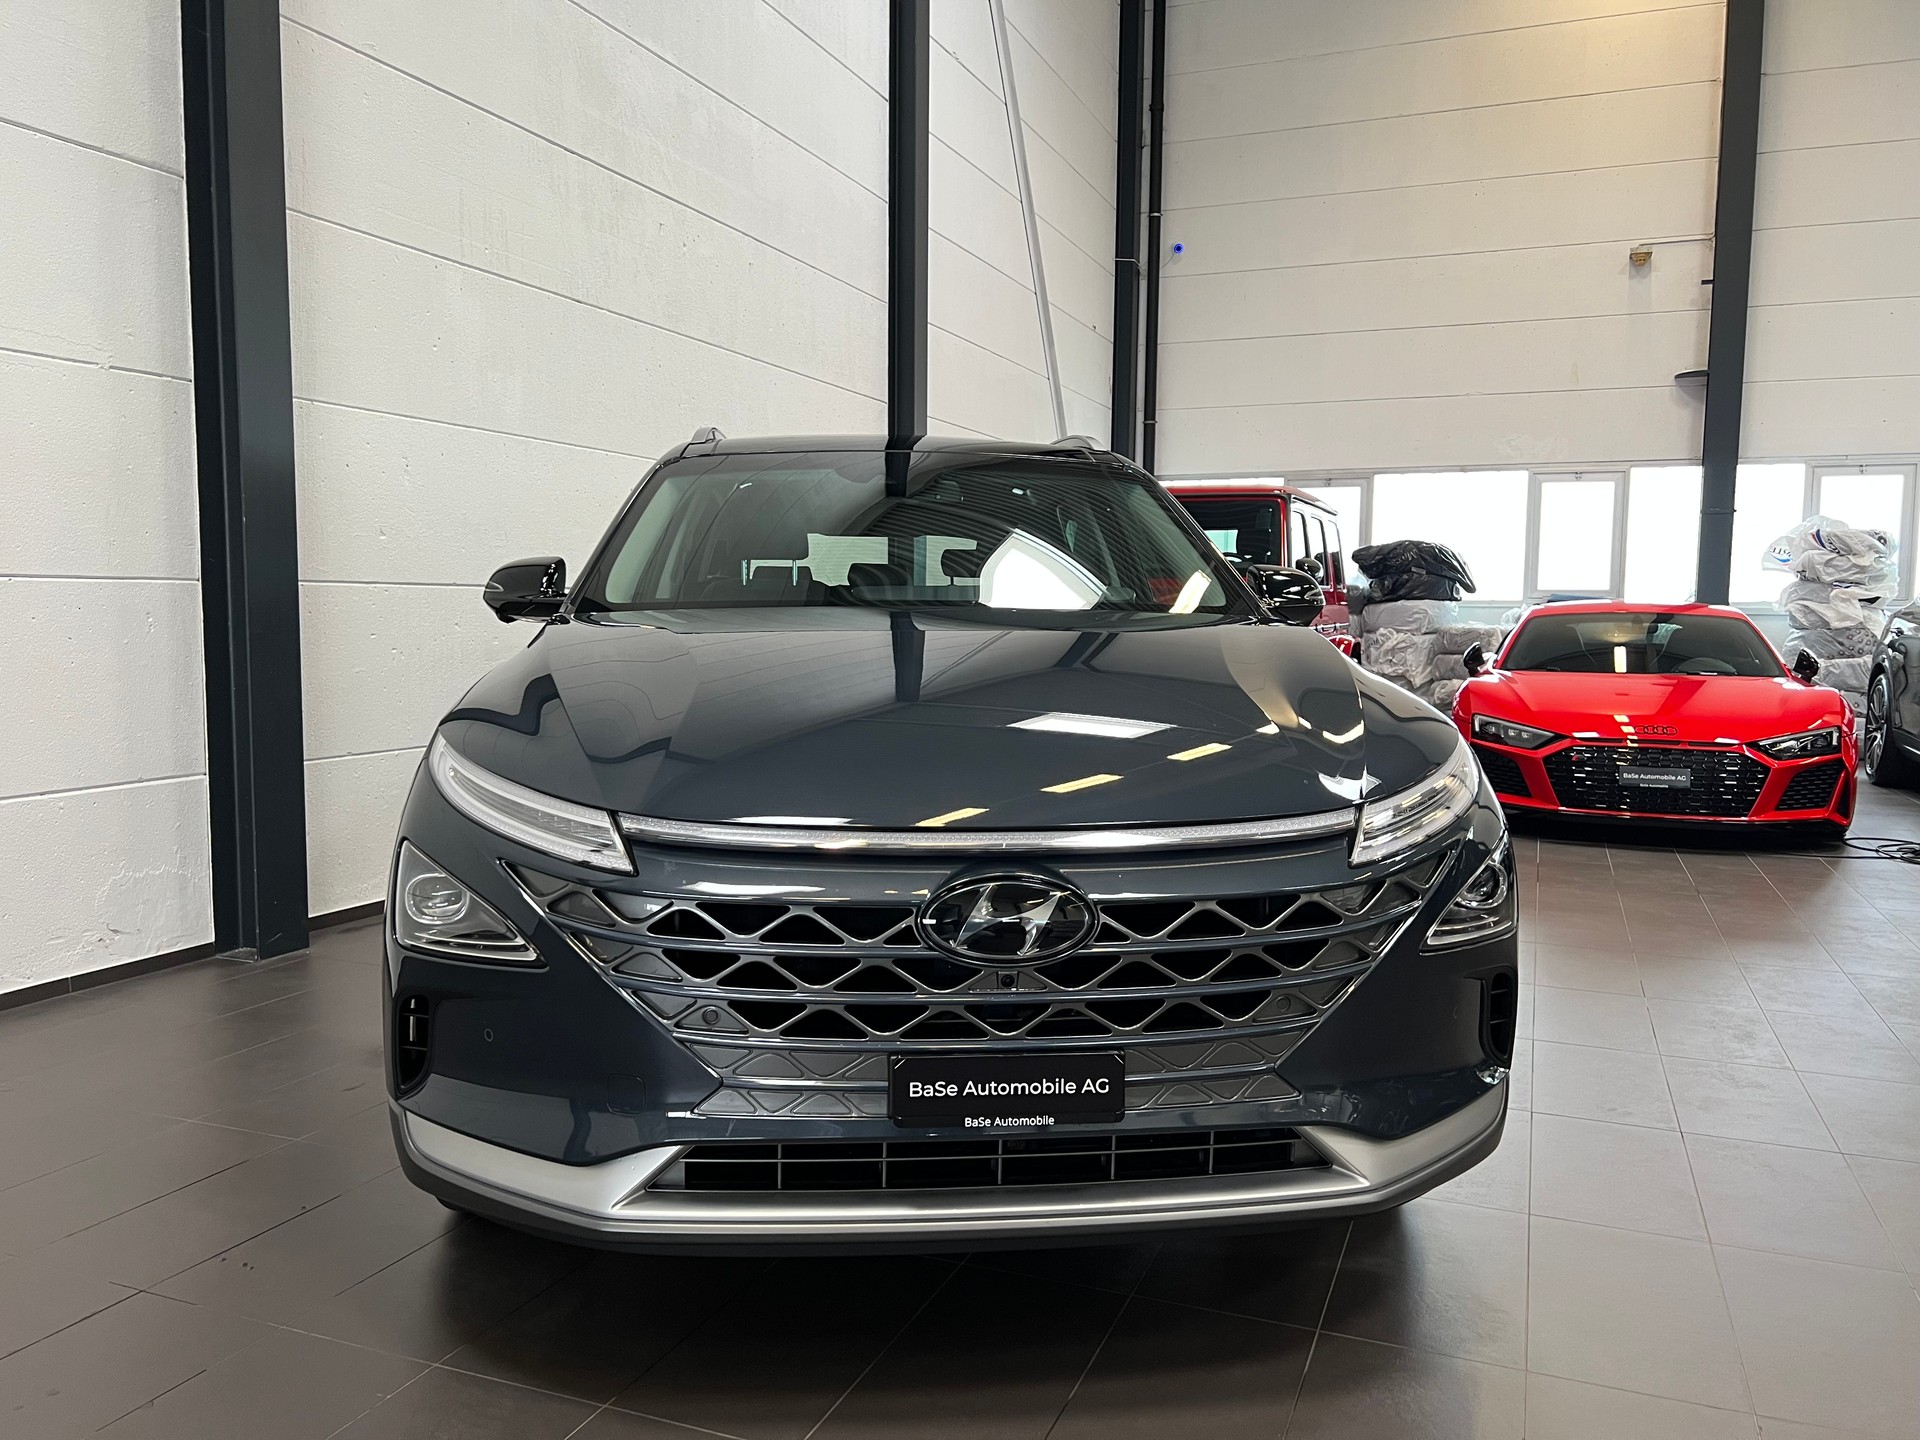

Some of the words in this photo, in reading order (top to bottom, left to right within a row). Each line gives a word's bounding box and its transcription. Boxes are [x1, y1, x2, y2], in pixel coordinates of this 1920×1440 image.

[909, 1081, 958, 1098] BaSe
[963, 1078, 1077, 1097] Automobile
[1081, 1078, 1110, 1094] AG
[964, 1117, 991, 1128] BaSe
[994, 1115, 1055, 1127] Automobile
